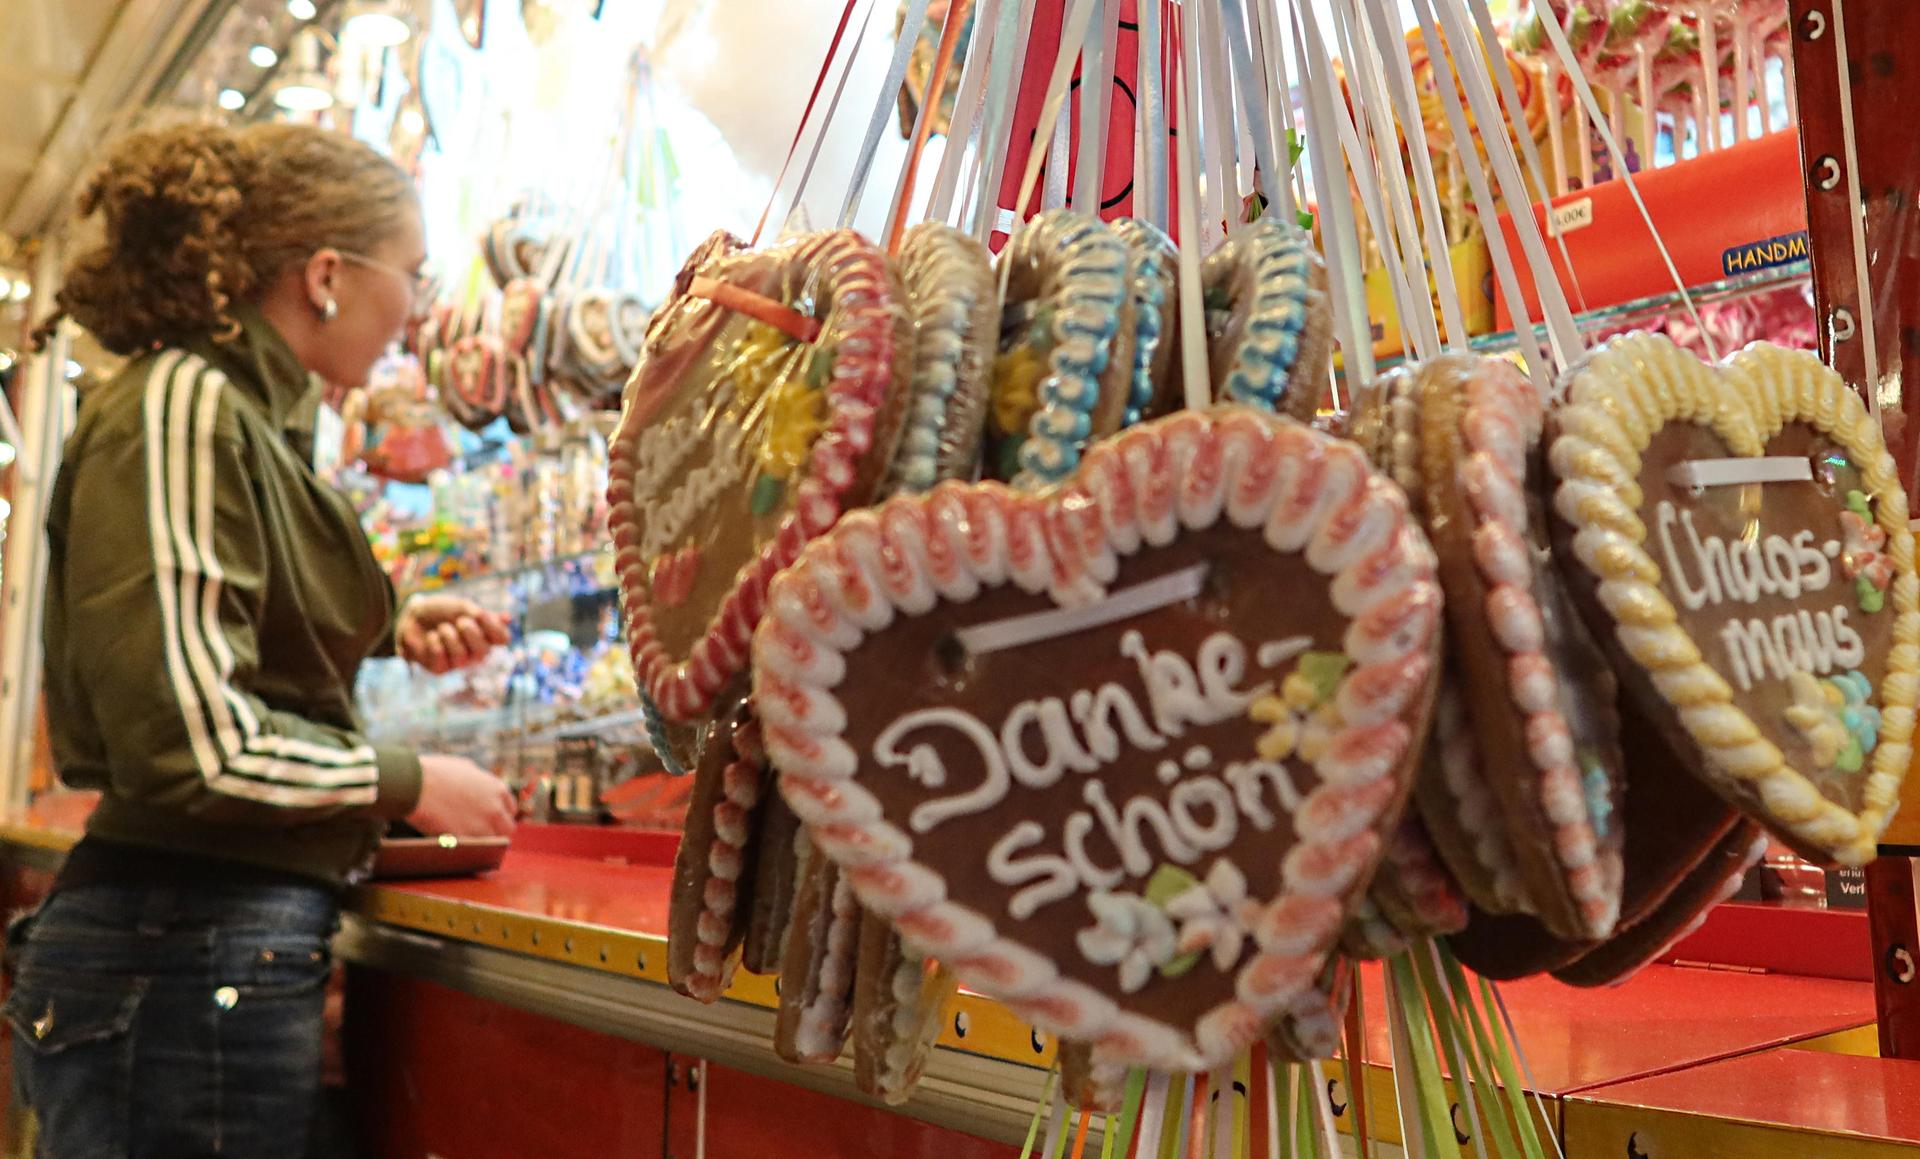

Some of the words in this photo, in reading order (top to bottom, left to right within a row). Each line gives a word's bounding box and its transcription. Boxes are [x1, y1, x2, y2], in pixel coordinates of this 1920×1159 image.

[1657, 500, 1840, 610] Chaos-
[1720, 604, 1865, 691] maus
[873, 629, 1314, 833] Danke-
